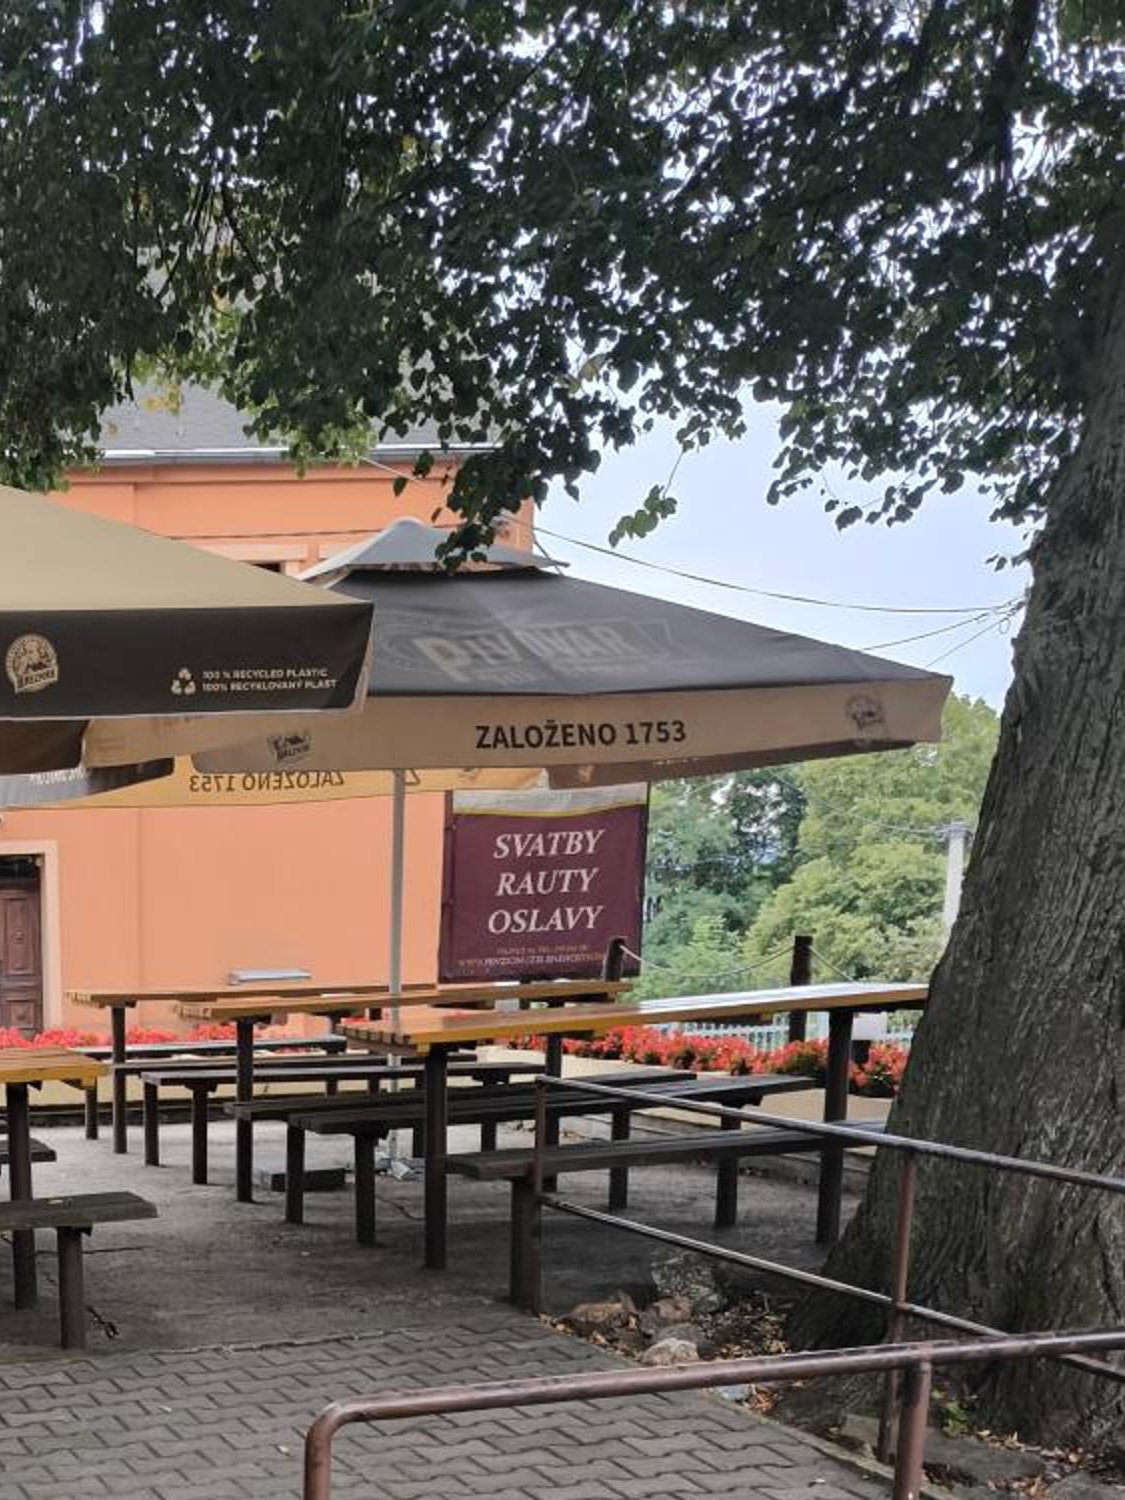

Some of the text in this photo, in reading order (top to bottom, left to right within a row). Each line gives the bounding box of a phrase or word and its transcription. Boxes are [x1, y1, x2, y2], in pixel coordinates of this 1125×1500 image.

[231, 669, 285, 679] RECYCLED
[286, 667, 329, 678] PLASTIC
[304, 679, 338, 689] PLAST
[475, 719, 686, 749] ZALOŽENO 1753
[493, 829, 606, 859] SVATBY
[496, 867, 599, 896] RAUTY
[488, 905, 604, 935] OSLAVY
